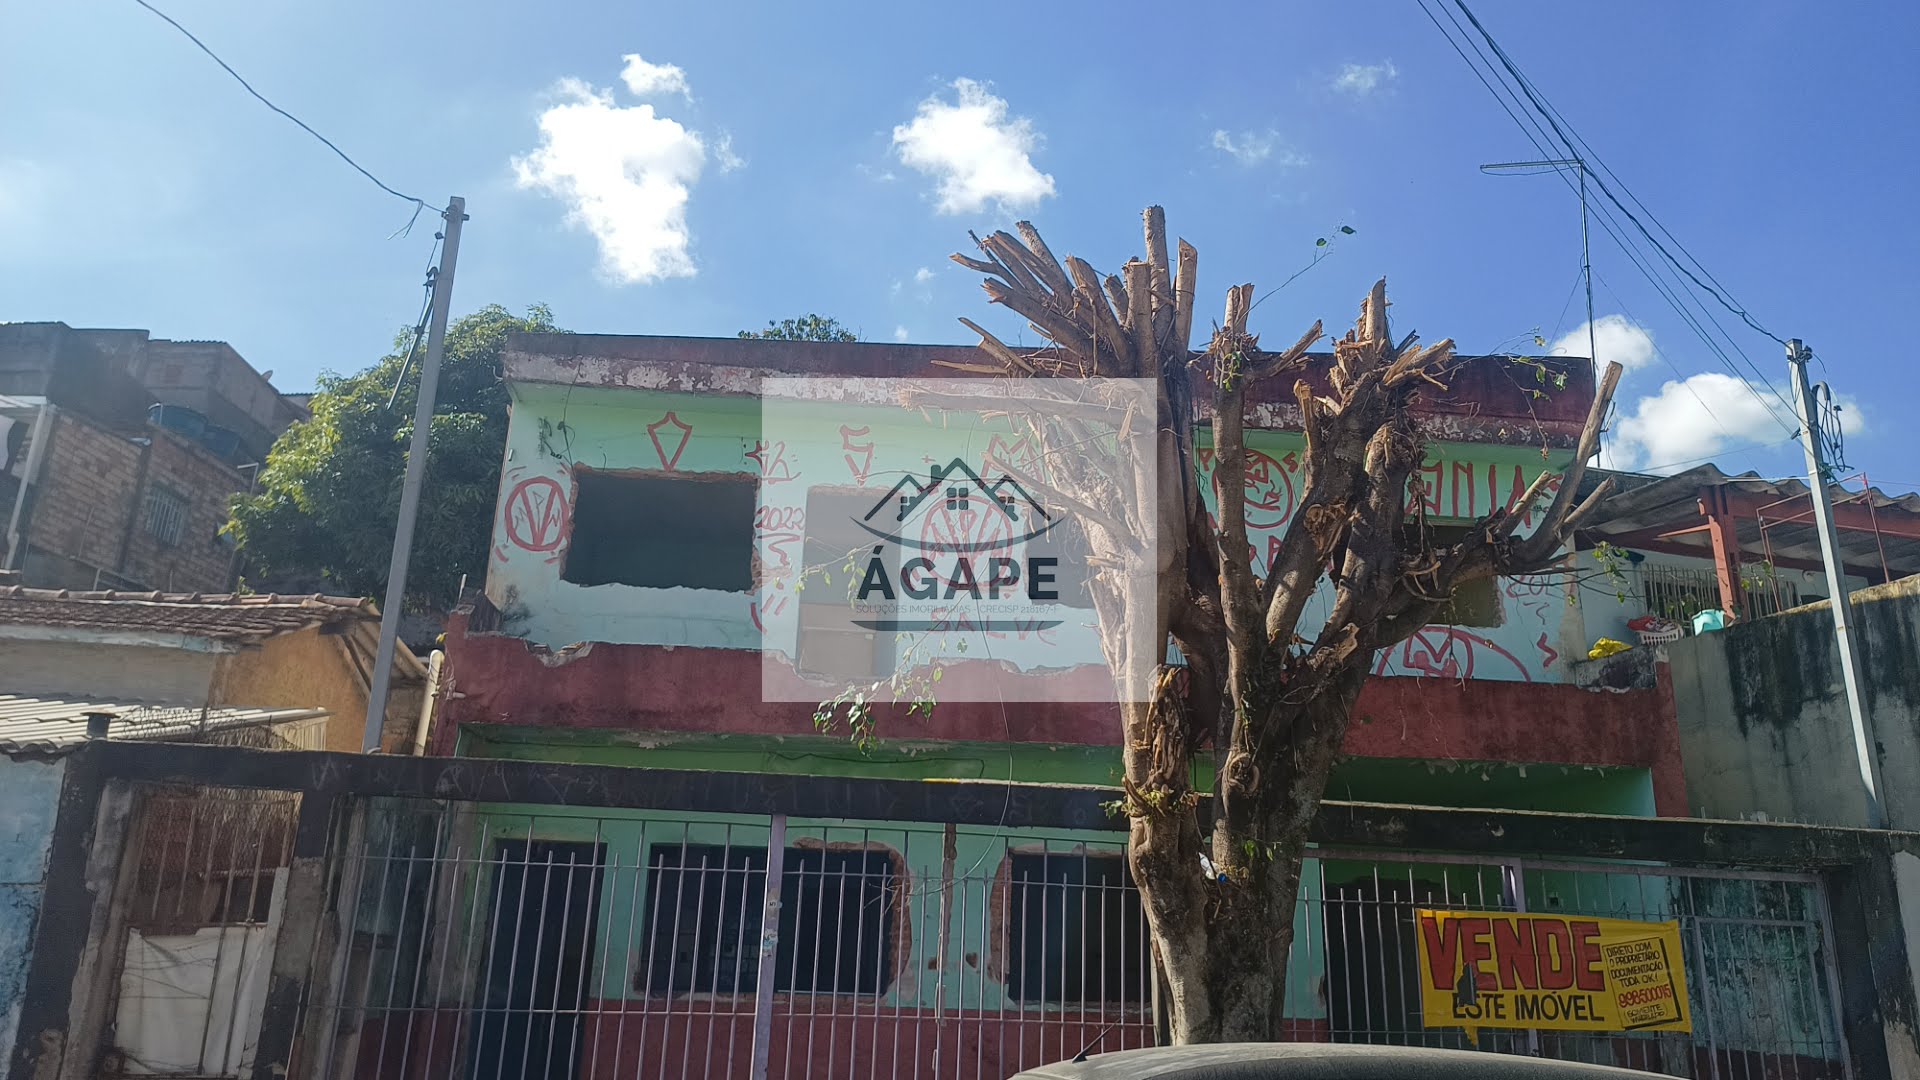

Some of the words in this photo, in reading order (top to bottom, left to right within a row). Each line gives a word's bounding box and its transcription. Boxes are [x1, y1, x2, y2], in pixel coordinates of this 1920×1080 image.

[1422, 916, 1606, 992] VENDE
[1606, 944, 1633, 957] DIRETO
[1635, 941, 1652, 952] COM
[1609, 958, 1615, 967] O
[1619, 975, 1640, 988] TODA
[1641, 973, 1659, 984] OK!
[1452, 992, 1506, 1019] ESTE
[1515, 990, 1605, 1022] IMÓVEL
